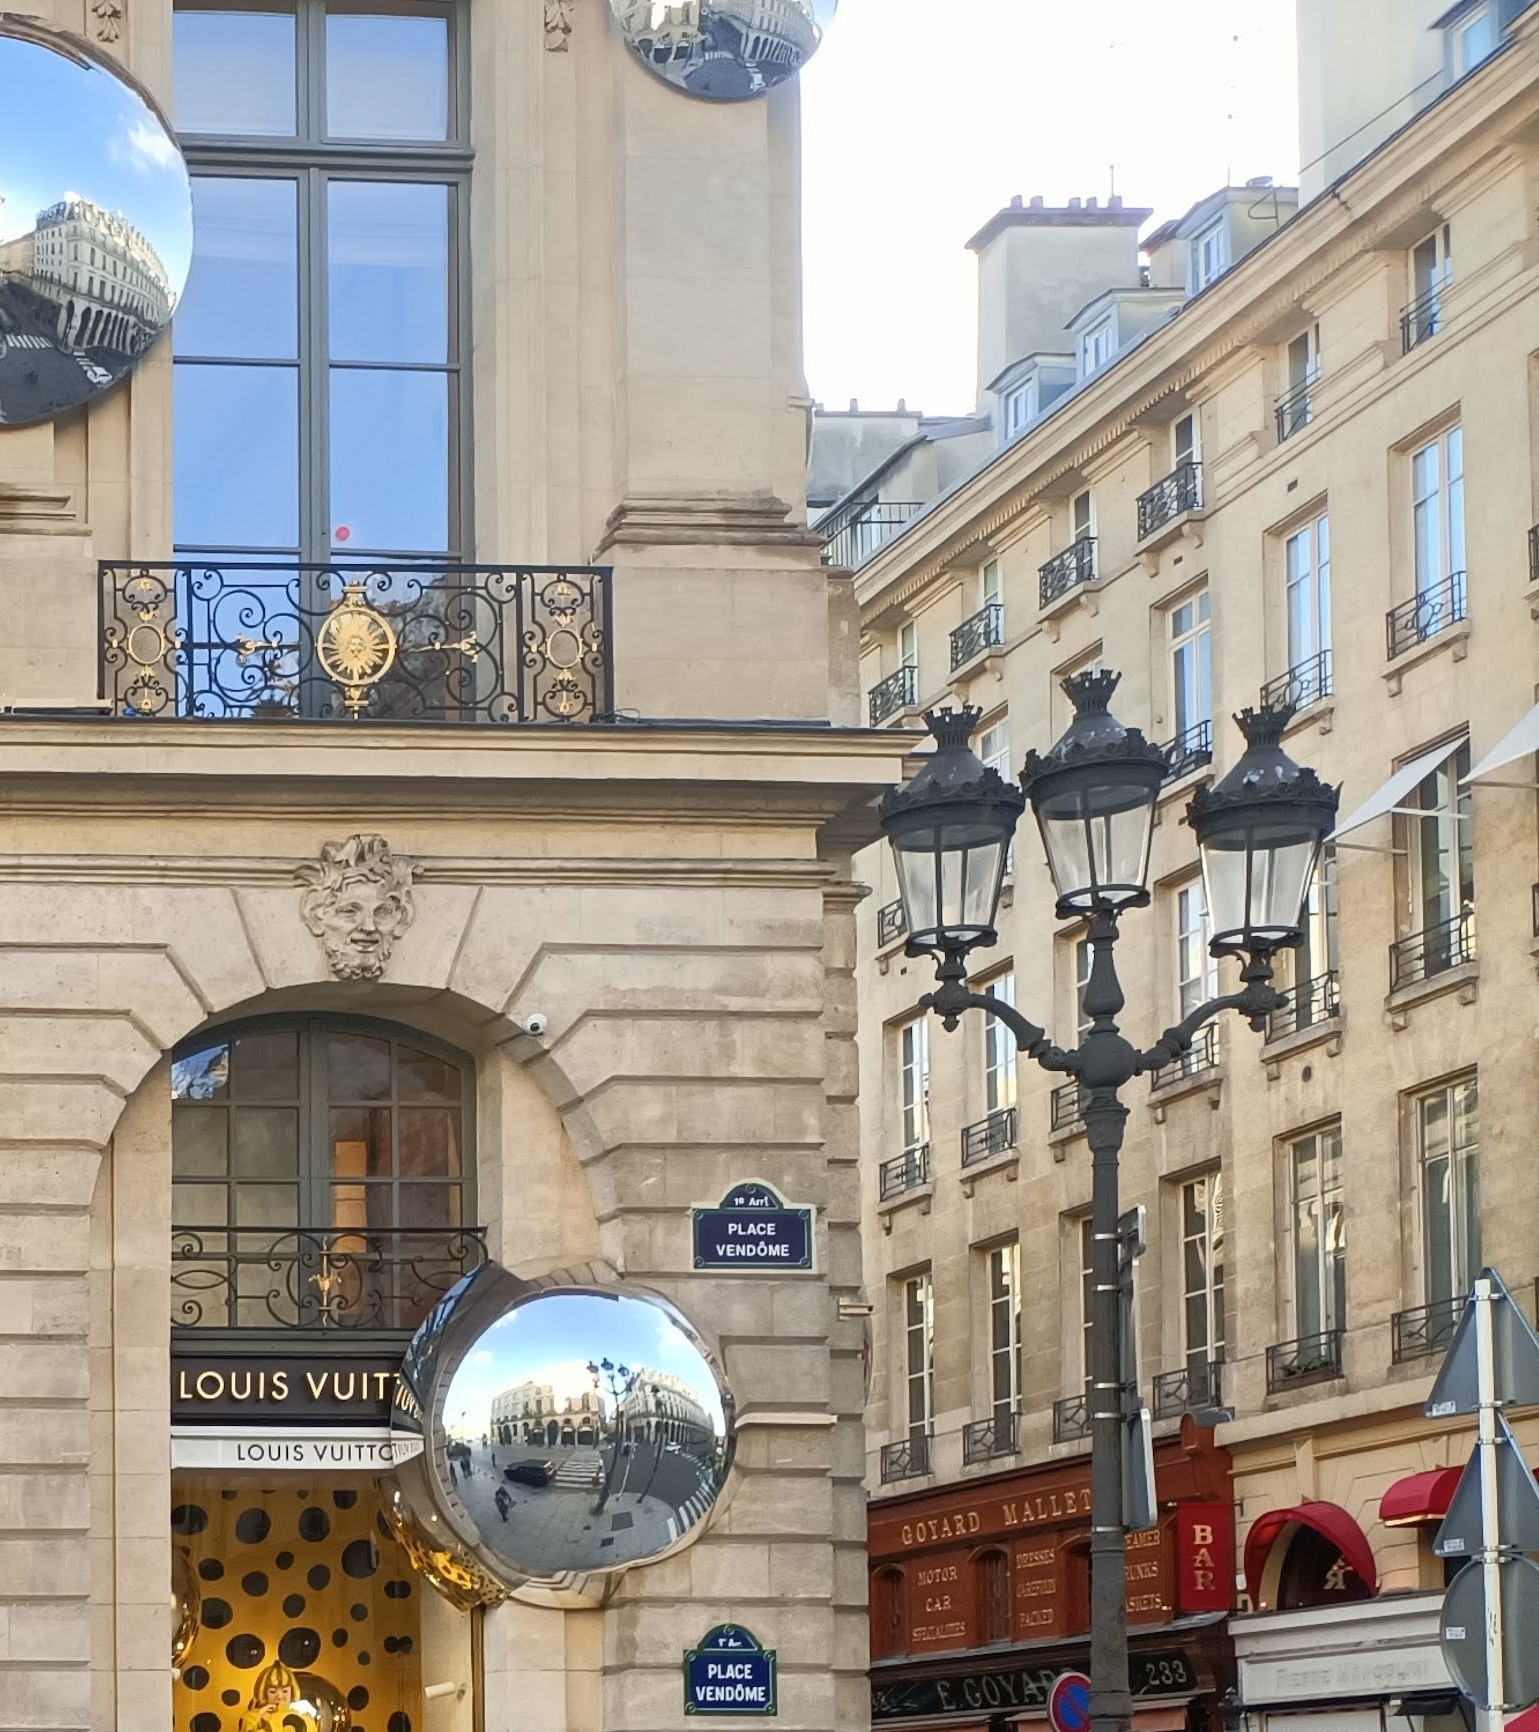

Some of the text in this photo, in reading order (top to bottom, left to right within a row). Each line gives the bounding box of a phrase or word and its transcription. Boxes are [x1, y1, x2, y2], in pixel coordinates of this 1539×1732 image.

[727, 1222, 777, 1236] PLACE
[716, 1240, 790, 1257] VENDÔME
[179, 1370, 398, 1401] LOUIS VUIT
[237, 1443, 395, 1463] LOUIS VUITTO
[901, 1487, 1092, 1546] GOYARD MALLET
[1124, 1528, 1161, 1551] EAMER
[1192, 1524, 1216, 1591] BAR
[917, 1565, 958, 1587] MOTOR
[1124, 1560, 1159, 1582] RUNKS
[925, 1595, 952, 1612] CAR
[707, 1663, 754, 1680] PLACE
[1145, 1660, 1187, 1686] 233
[695, 1683, 767, 1702] VENDÔME
